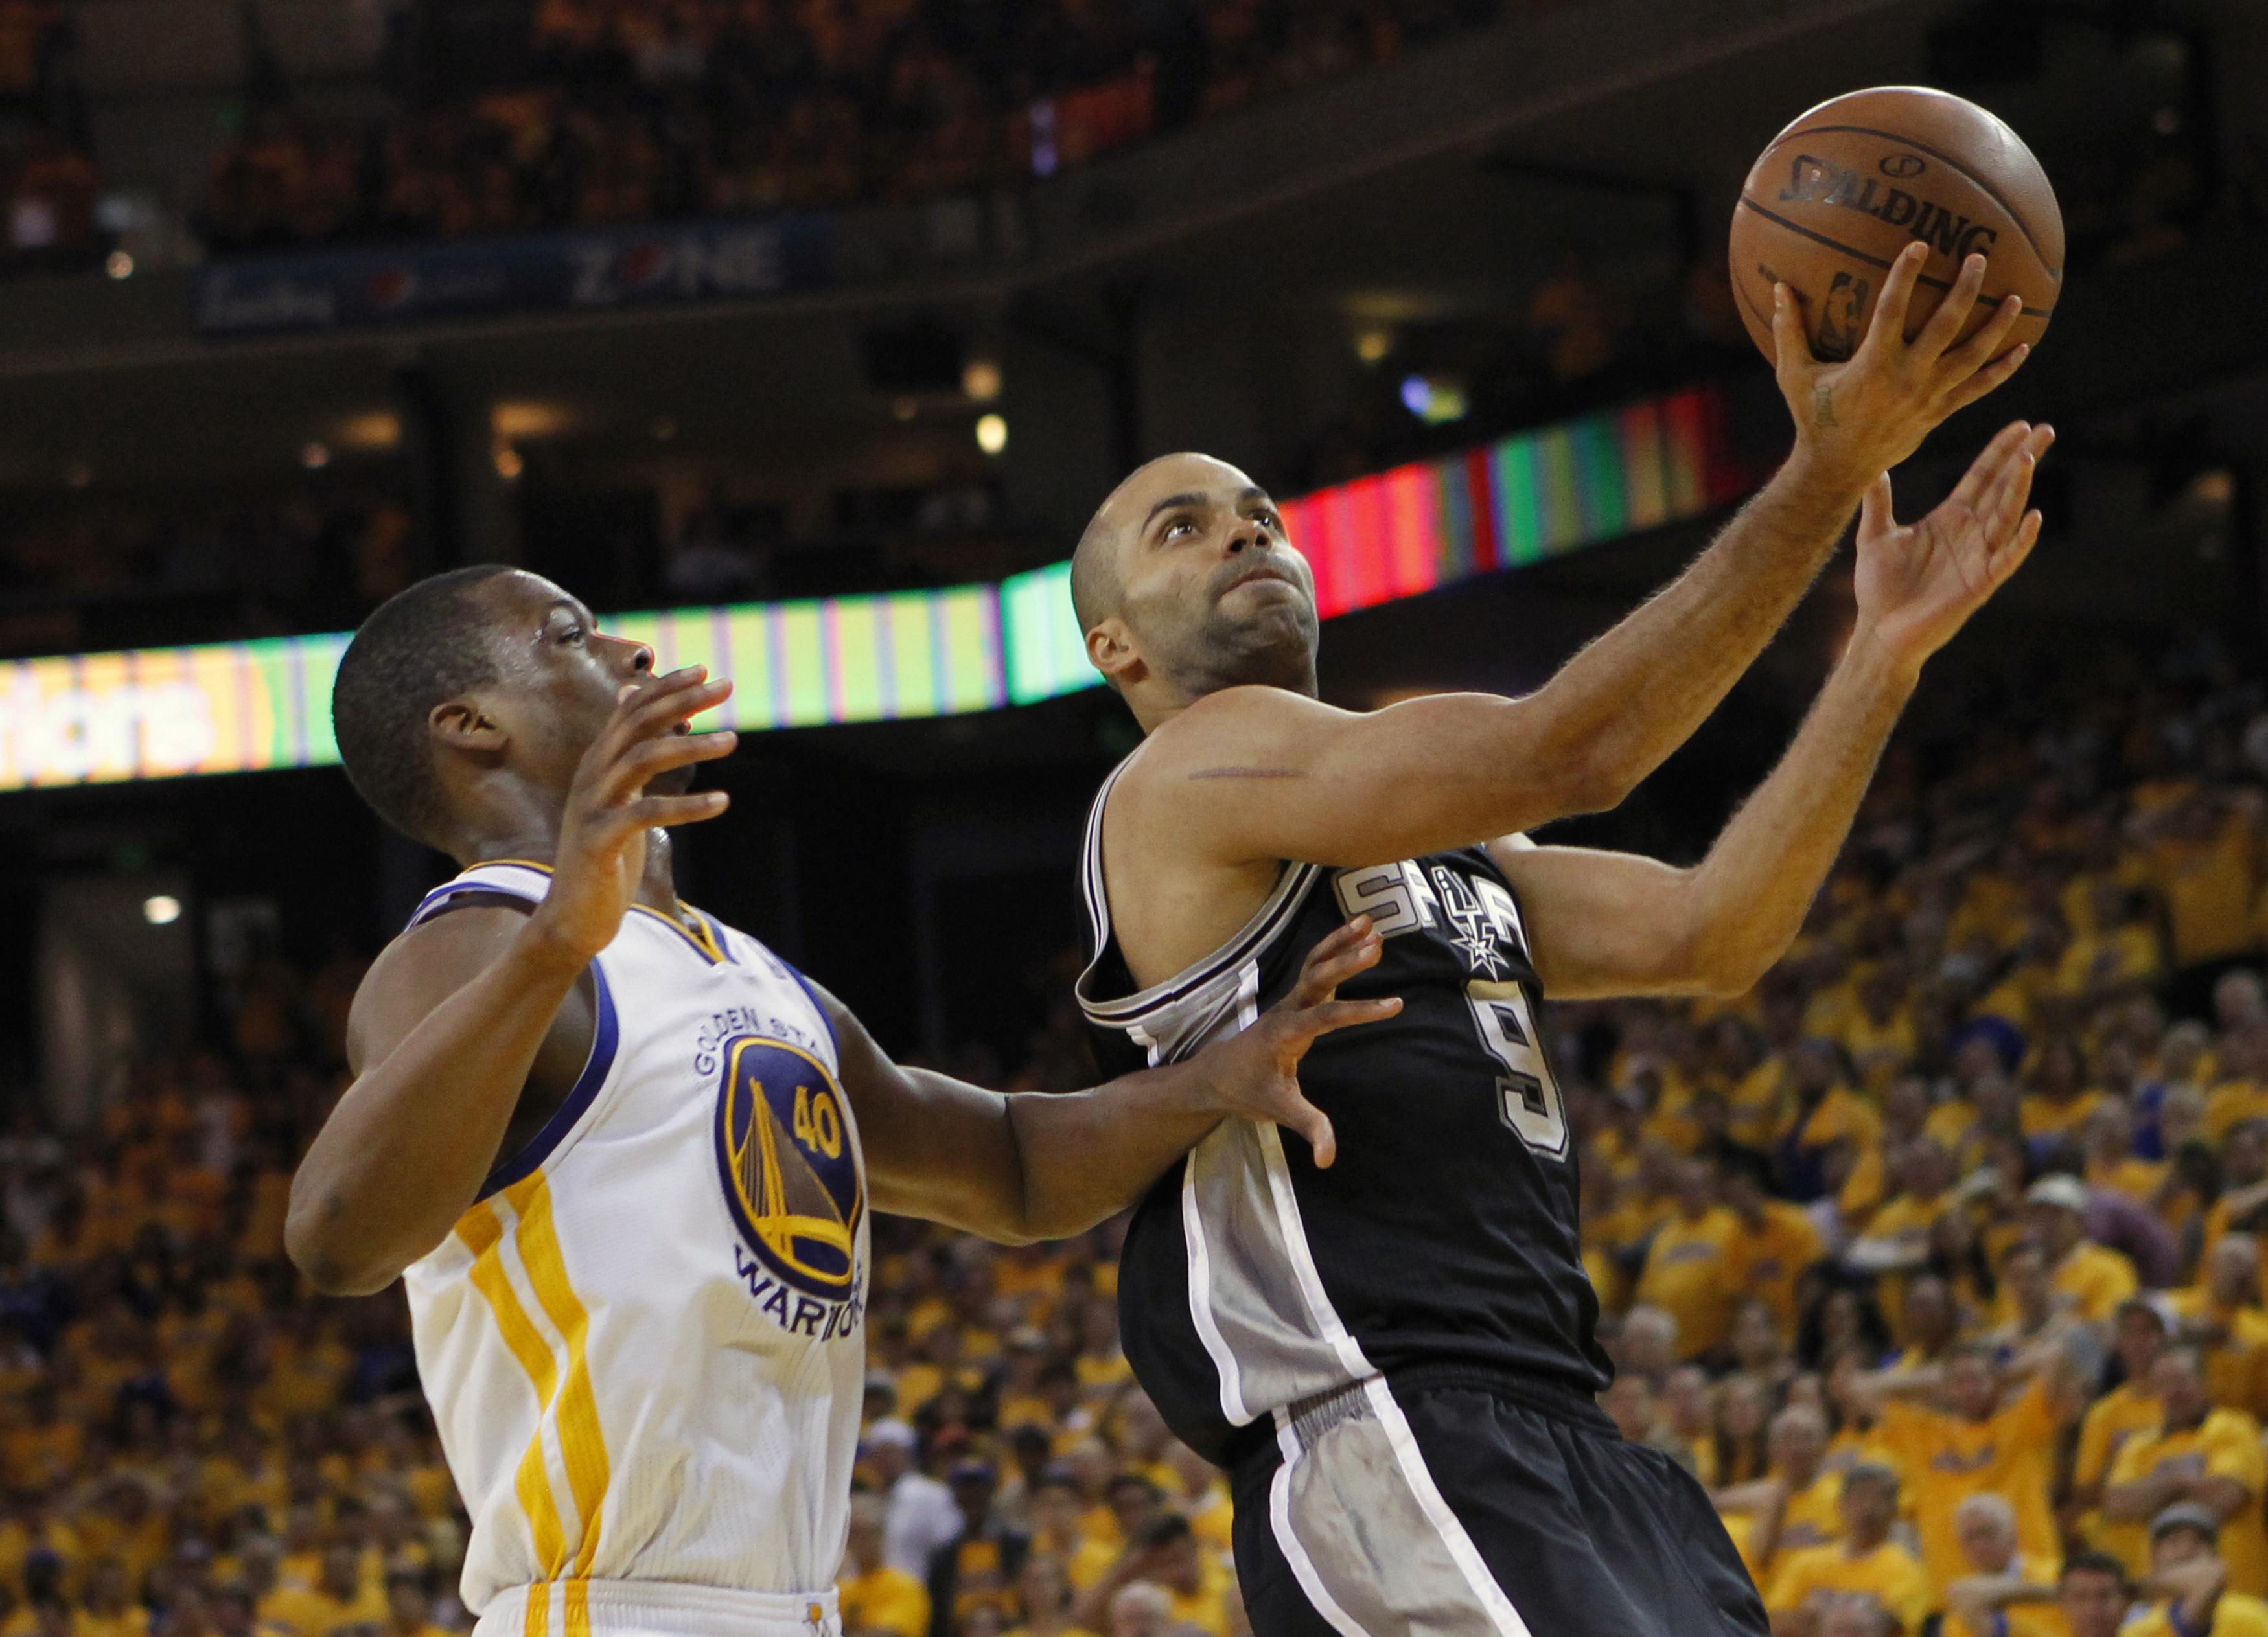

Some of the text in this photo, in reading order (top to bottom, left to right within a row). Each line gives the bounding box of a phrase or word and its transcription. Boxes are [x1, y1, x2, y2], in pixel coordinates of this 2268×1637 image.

[1779, 154, 1997, 260] SPALDING
[793, 1086, 842, 1160] 40
[1462, 979, 1570, 1163] 9
